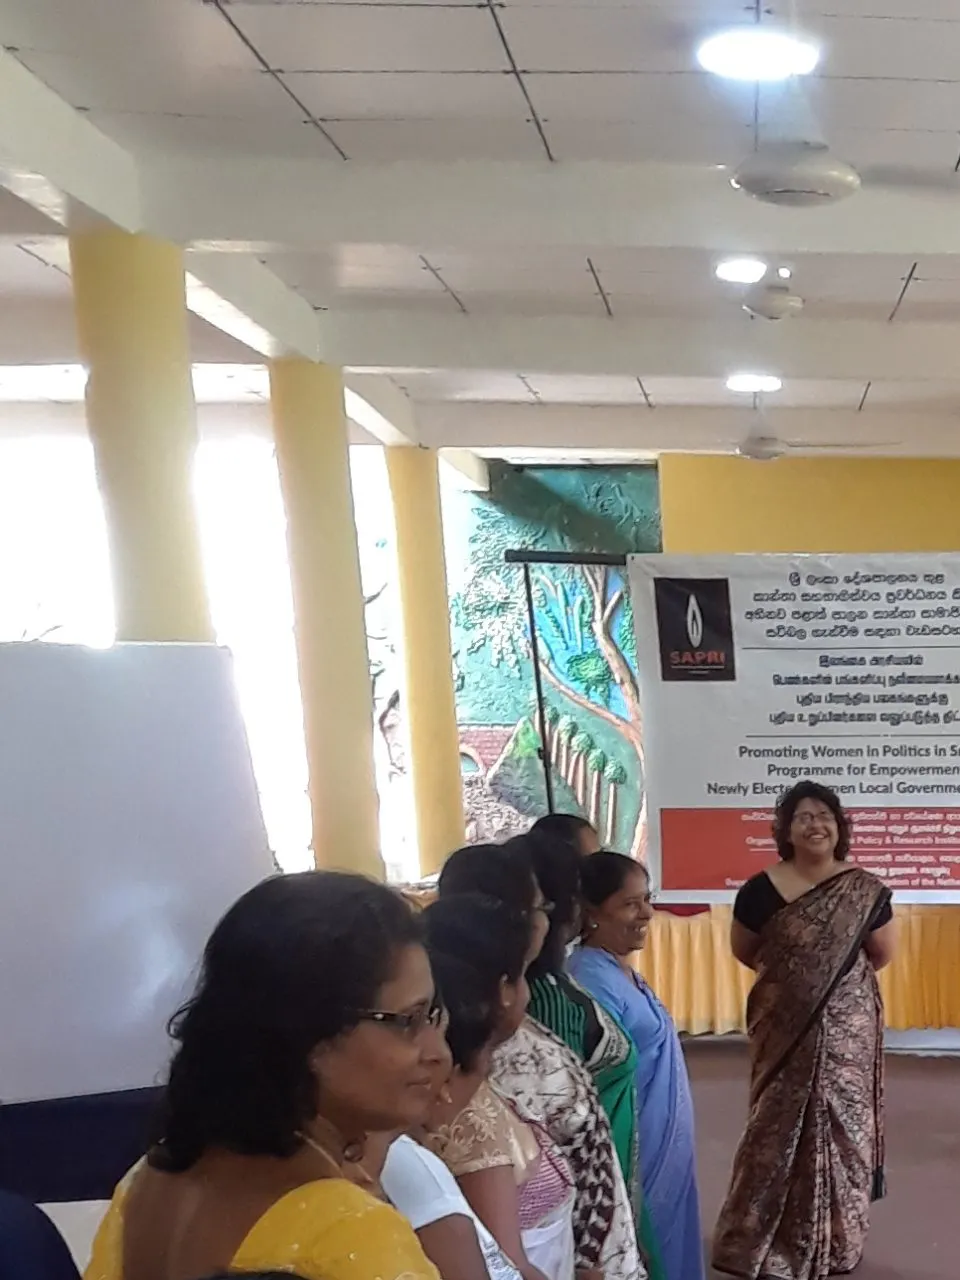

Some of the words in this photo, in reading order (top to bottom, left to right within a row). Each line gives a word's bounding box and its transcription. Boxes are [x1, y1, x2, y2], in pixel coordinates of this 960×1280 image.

[670, 650, 725, 665] SAPRI
[739, 745, 808, 760] Promoting
[811, 745, 863, 758] Women
[867, 745, 879, 758] in
[882, 745, 932, 758] Politics
[934, 745, 947, 758] in
[767, 763, 843, 778] Programme
[846, 762, 866, 776] for
[707, 782, 749, 796] Newly
[752, 782, 793, 795] Electe
[859, 781, 893, 795] Local
